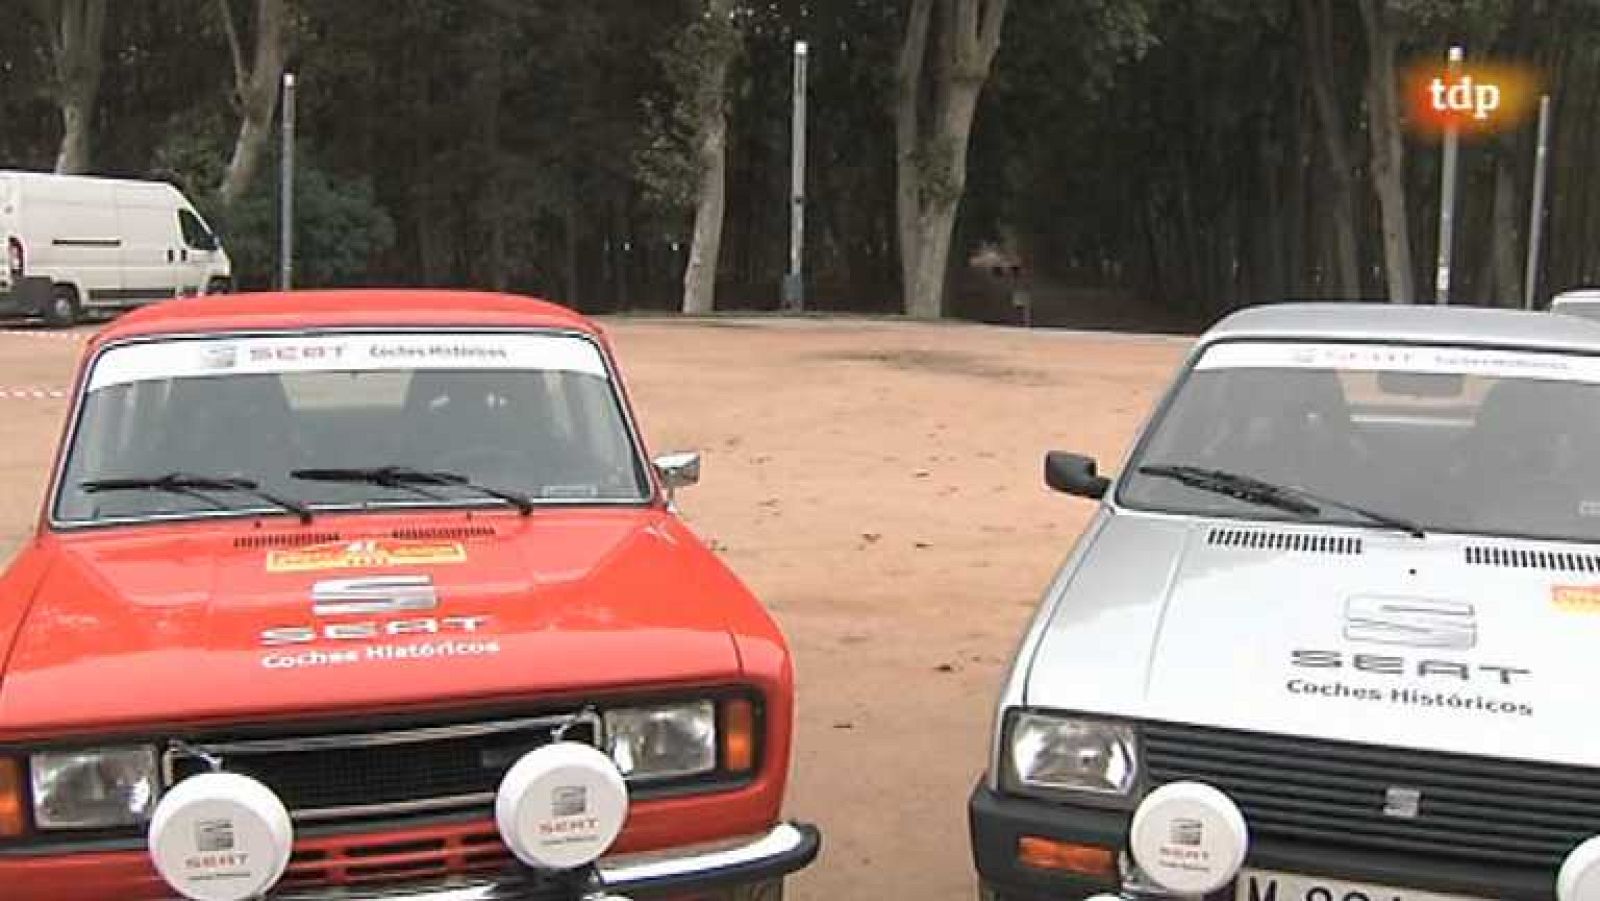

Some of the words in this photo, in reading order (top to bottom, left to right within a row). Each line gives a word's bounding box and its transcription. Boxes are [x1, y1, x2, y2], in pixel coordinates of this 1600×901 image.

[261, 616, 488, 645] SEAT
[261, 651, 359, 668] Coches
[1290, 650, 1532, 684] SEAT
[1286, 679, 1383, 701] Coches
[1390, 687, 1535, 718] Históricos
[537, 817, 600, 835] SEAT
[184, 853, 247, 868] SEAT
